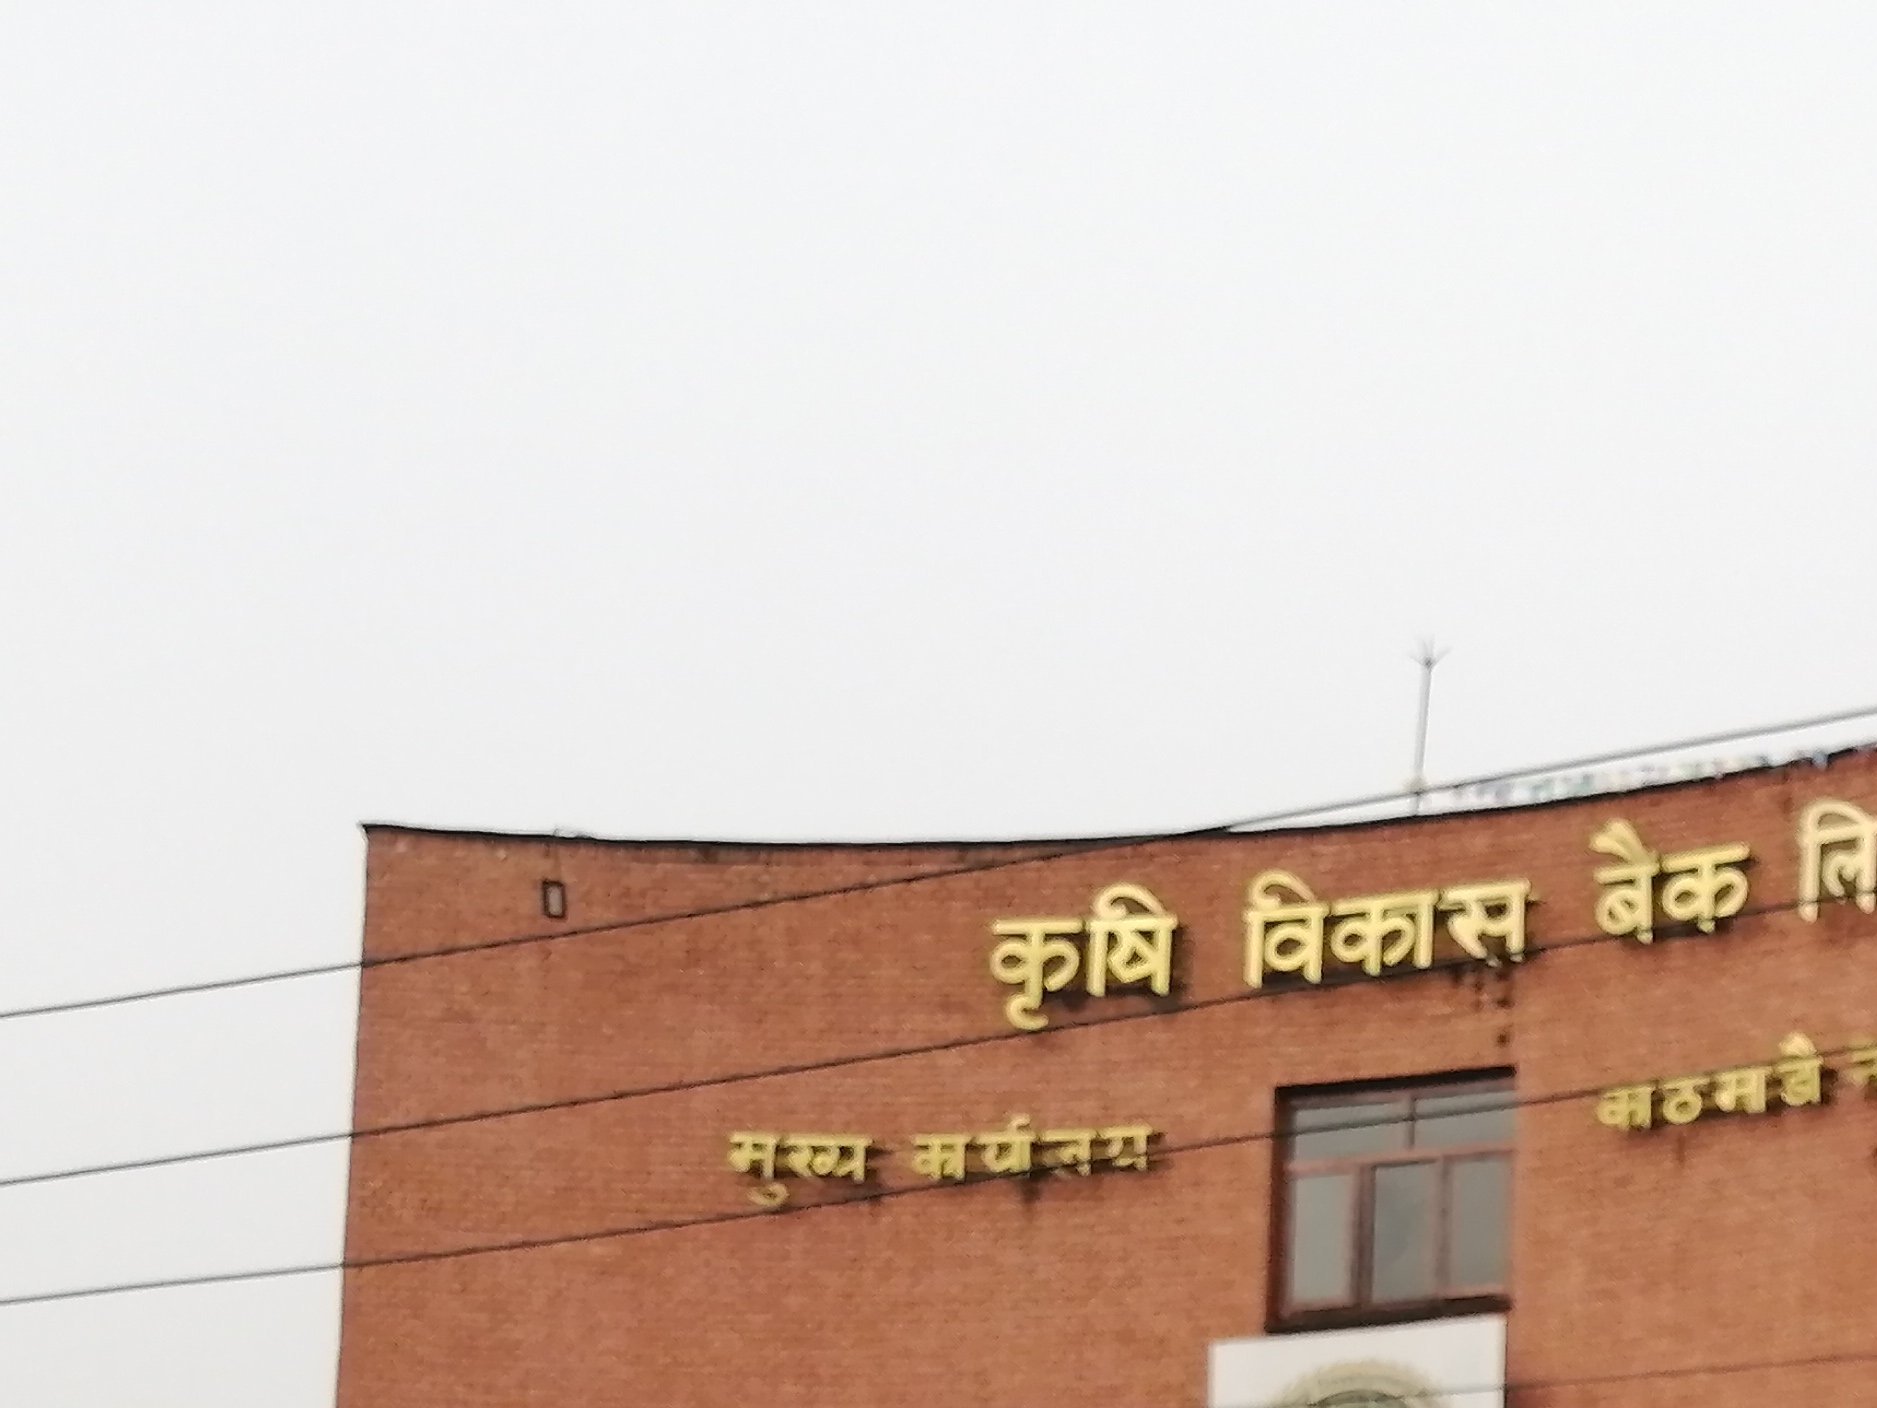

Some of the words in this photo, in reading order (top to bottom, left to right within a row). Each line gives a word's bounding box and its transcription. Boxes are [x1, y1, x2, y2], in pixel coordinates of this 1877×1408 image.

[990, 882, 1180, 1031] कृषि
[1243, 868, 1532, 989] विकास
[728, 1130, 874, 1208] मुख्य
